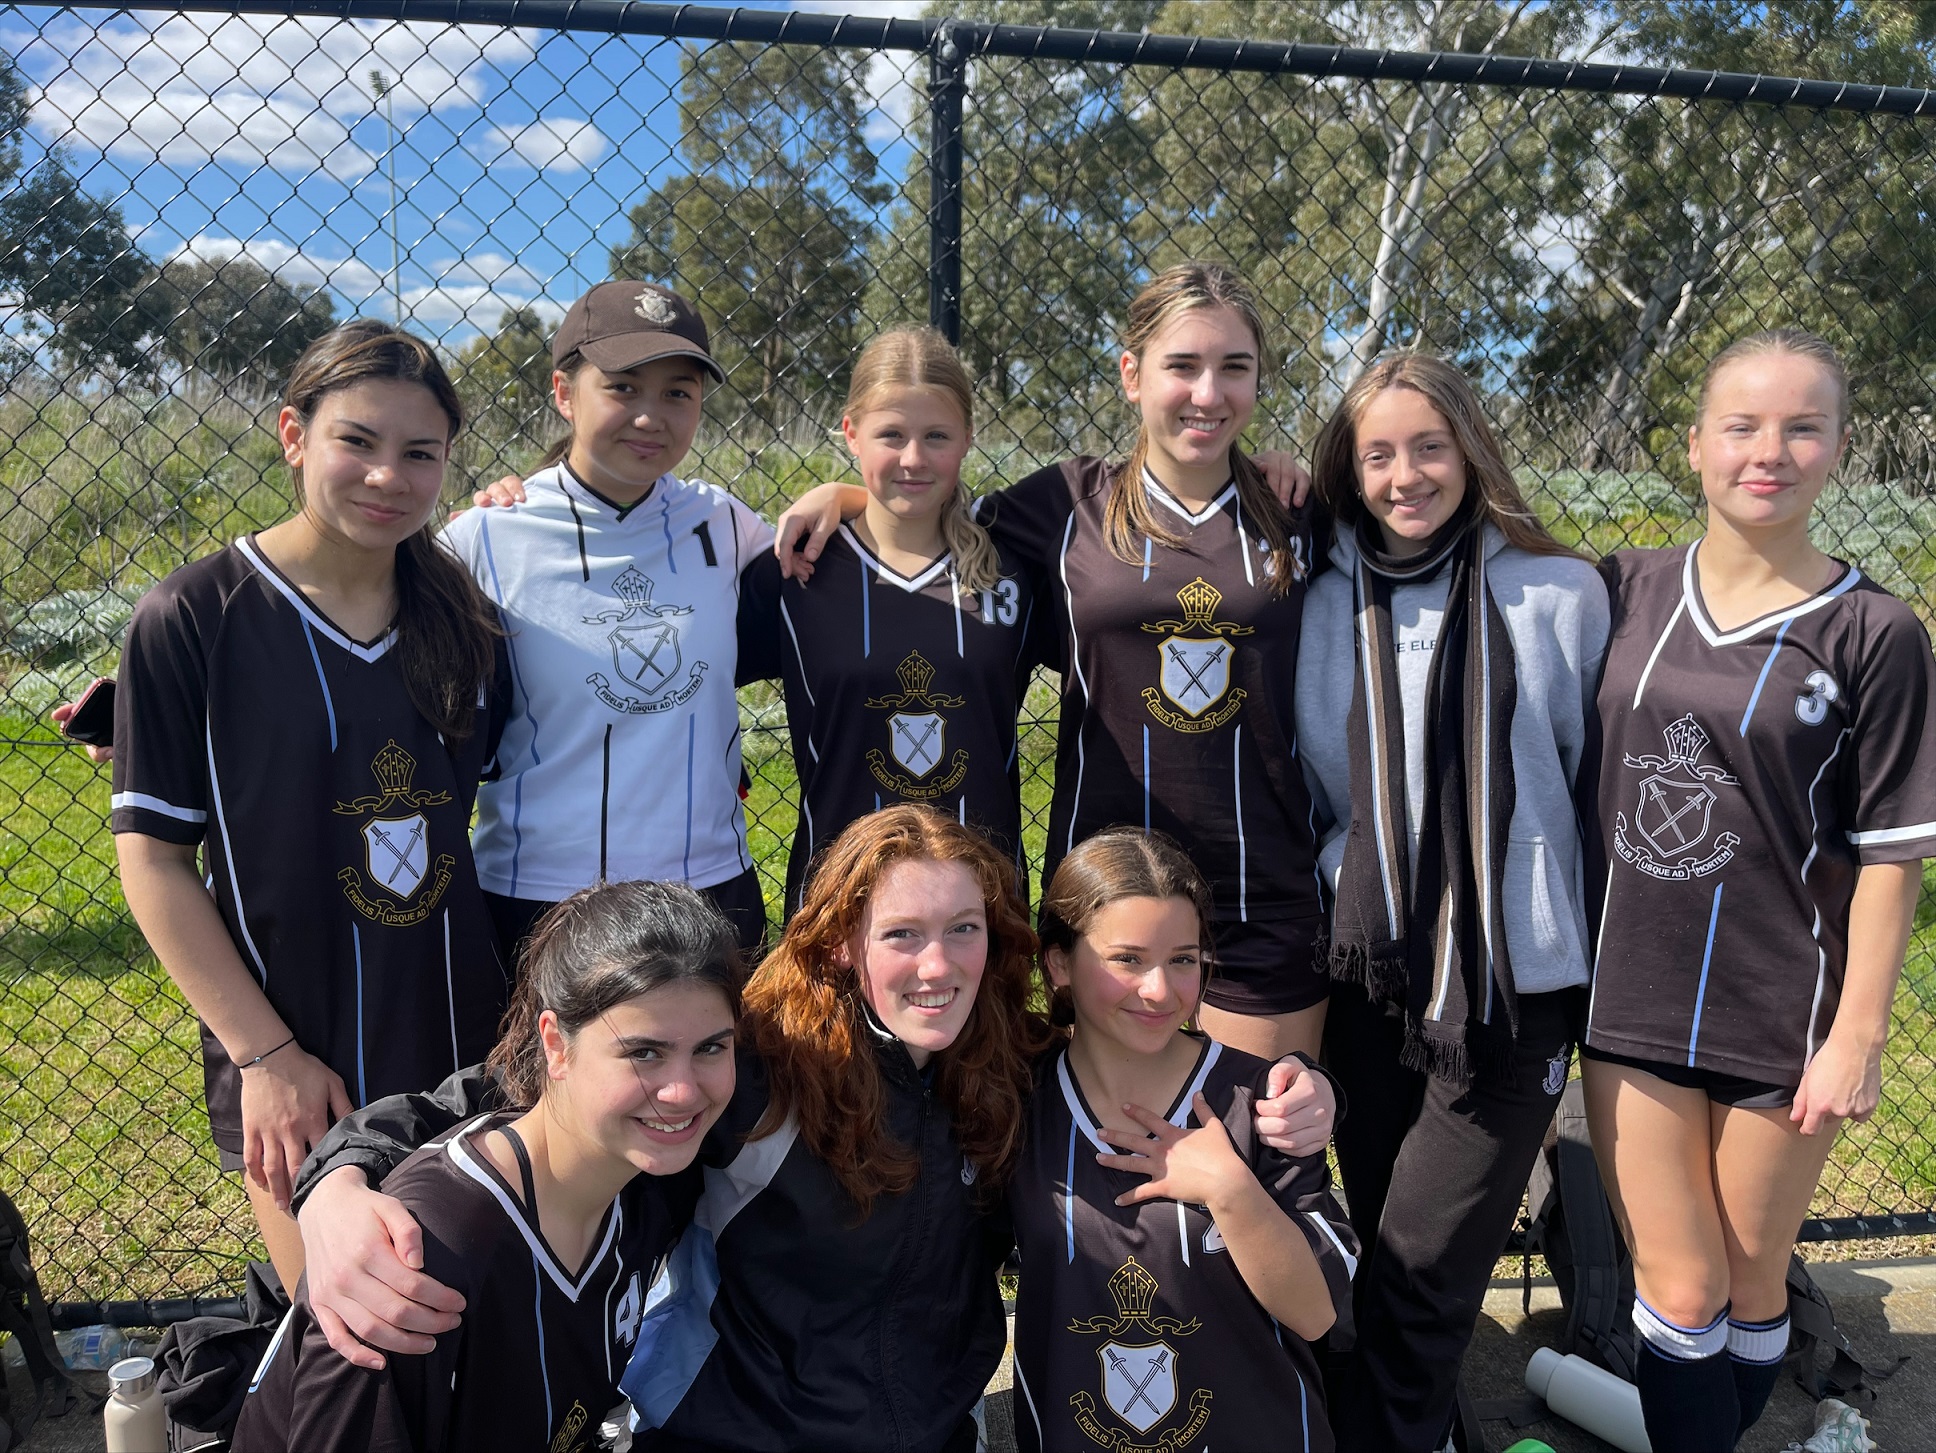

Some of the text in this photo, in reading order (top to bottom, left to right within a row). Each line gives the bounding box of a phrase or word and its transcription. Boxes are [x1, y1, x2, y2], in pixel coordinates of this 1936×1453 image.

[692, 520, 719, 568] 1
[981, 577, 1020, 627] 13
[600, 678, 701, 713] FIDELIS USQUE AD MORTEM
[1795, 669, 1840, 726] 3
[1149, 702, 1238, 731] FIDELIS USQUE AD MORTEM
[873, 766, 965, 797] FIDELIS USQUE AD MORTEM
[1640, 861, 1671, 877] USQUE
[1671, 870, 1686, 878] AD
[1695, 850, 1731, 875] MORTEM
[348, 889, 375, 916] FIDELIS
[386, 913, 416, 924] USQUE
[416, 908, 427, 919] AD
[615, 1270, 644, 1349] 4
[1079, 1415, 1109, 1444] FIDELIS
[1177, 1409, 1208, 1445] MORTEM
